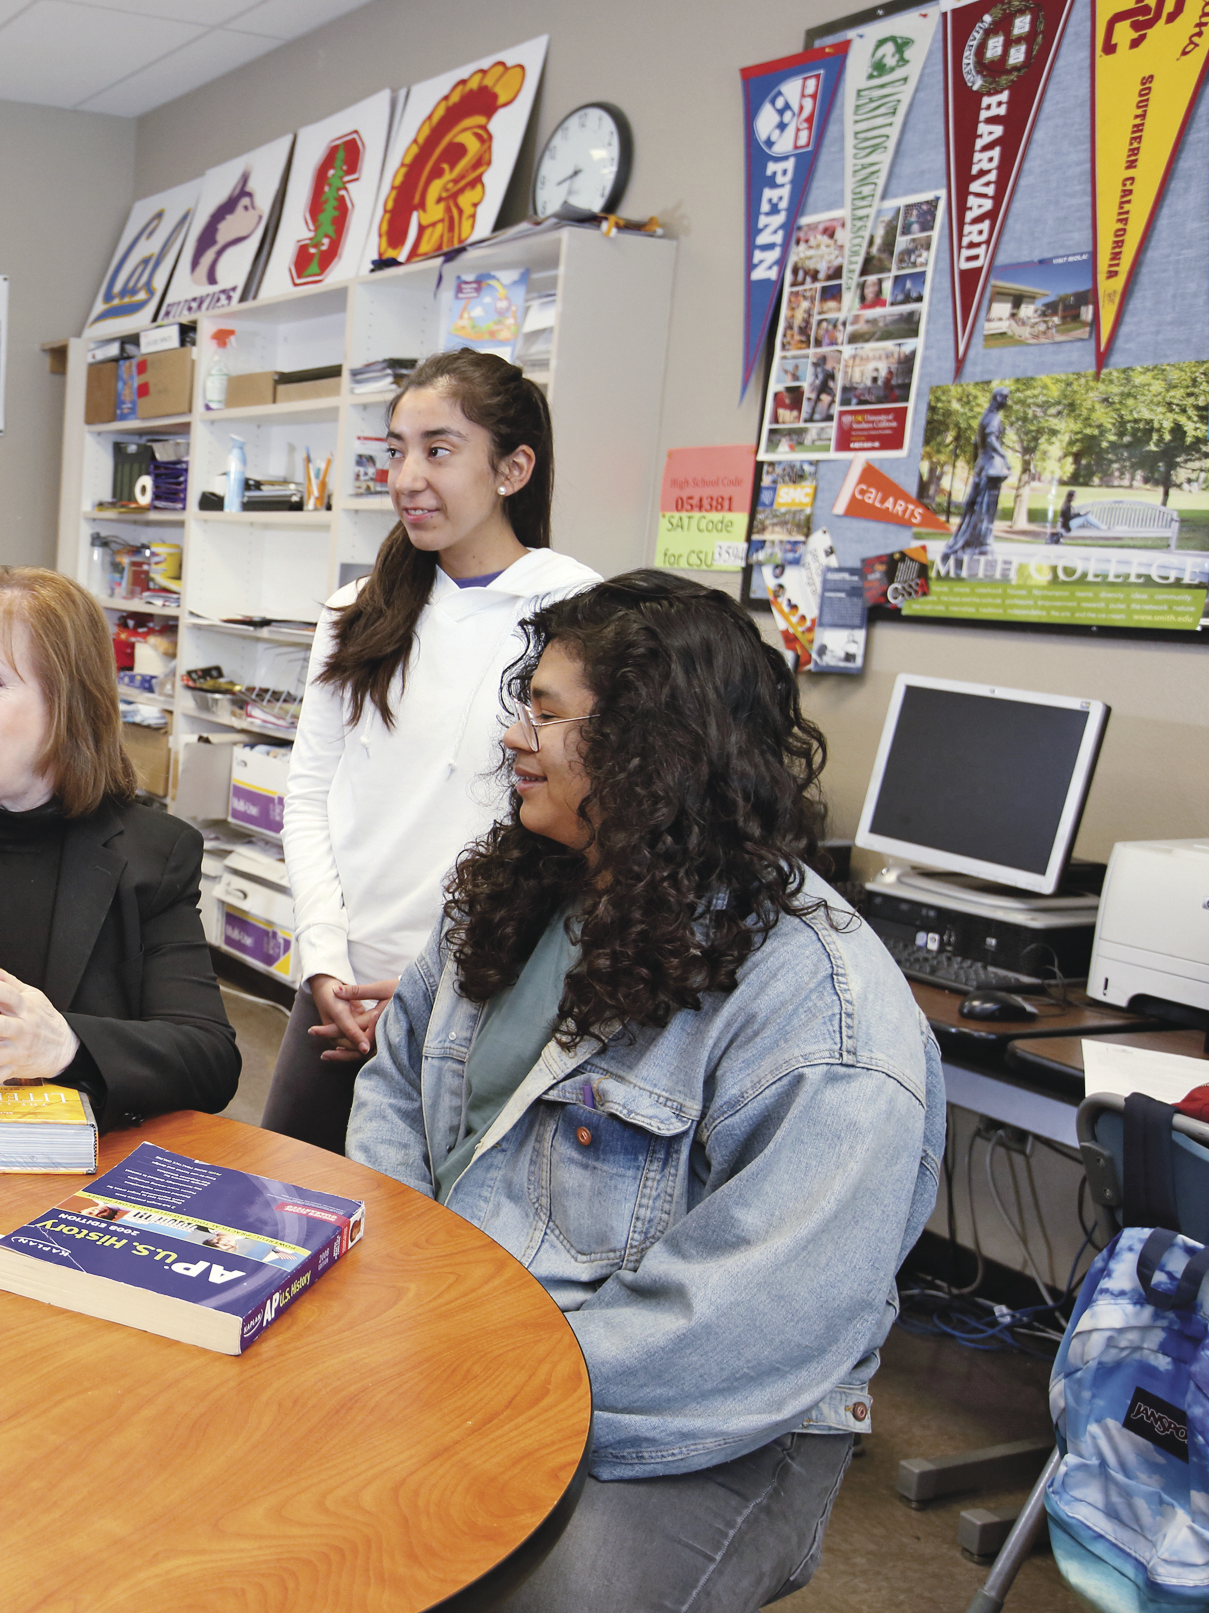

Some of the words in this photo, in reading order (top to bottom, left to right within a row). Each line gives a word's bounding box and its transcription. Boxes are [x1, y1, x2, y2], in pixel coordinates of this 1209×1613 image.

[853, 75, 908, 124] EAST
[1123, 74, 1154, 171] SOUTHERN
[853, 122, 894, 160] LOS
[850, 159, 884, 235] ANGELES
[960, 90, 1010, 271] HARVARD
[750, 157, 795, 282] PENN
[1105, 176, 1136, 281] CALIFORNIA
[95, 207, 192, 314] Cal
[161, 285, 238, 321] HUSKIES
[670, 477, 689, 489] High
[692, 476, 719, 487] School
[721, 476, 743, 487] Code
[777, 487, 812, 504] SMC
[675, 495, 734, 513] 054381
[666, 515, 694, 533] SAT
[696, 514, 734, 533] Code
[663, 549, 682, 567] for
[686, 550, 714, 567] CSU
[931, 554, 1019, 585] MITH
[1028, 553, 1203, 585] COLLEGE
[35, 1216, 129, 1249] History
[57, 1213, 108, 1227] EDITION
[107, 1224, 140, 1235] 2008
[15, 1237, 70, 1256] KAPLAN
[123, 1241, 180, 1263] U.S.
[166, 1259, 247, 1288] AP
[243, 1313, 262, 1333] KAPLAN
[263, 1292, 280, 1327] AP
[279, 1287, 291, 1307] U.S.
[291, 1270, 311, 1297] History
[1131, 1402, 1188, 1444] JANSPO
